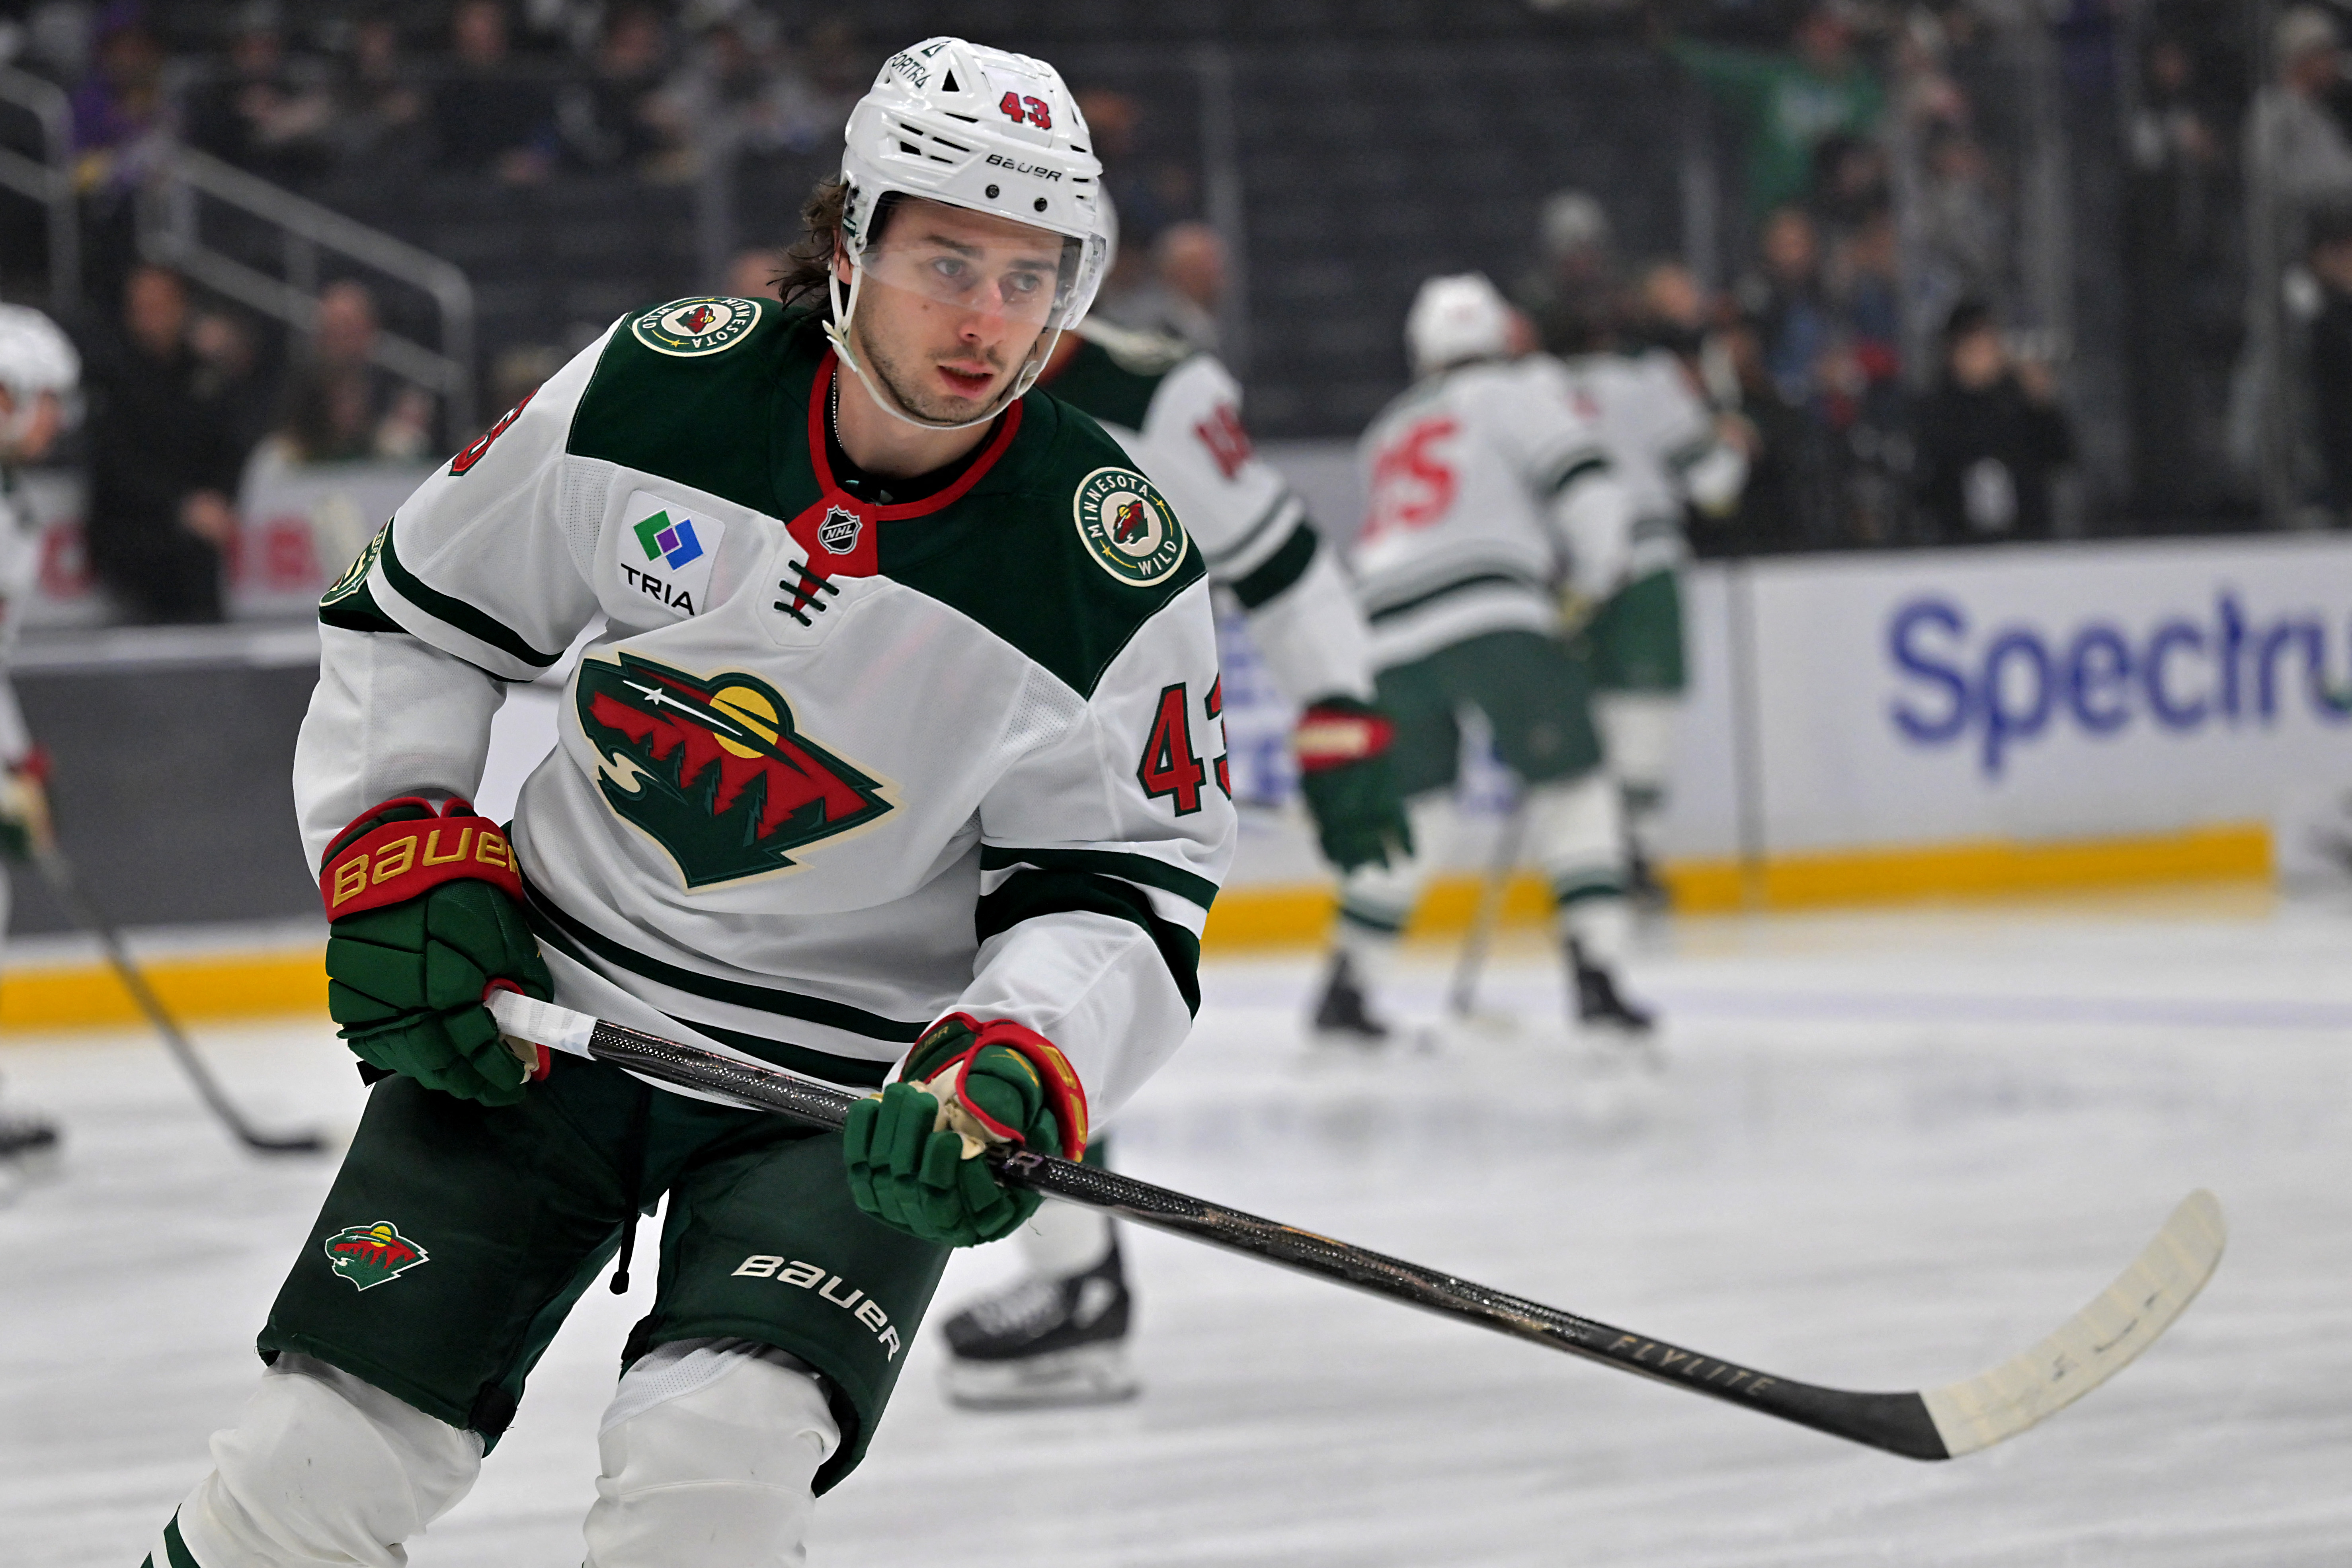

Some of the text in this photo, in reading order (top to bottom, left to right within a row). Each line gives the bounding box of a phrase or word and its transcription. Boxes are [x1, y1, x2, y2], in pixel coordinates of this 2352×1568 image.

[999, 91, 1052, 131] 43
[642, 307, 674, 329] WILD
[691, 298, 751, 349] MINNESOTA
[1083, 475, 1149, 538] MINNESOTA
[368, 531, 383, 562] 2025
[825, 524, 853, 540] NHL
[1137, 541, 1177, 576] WILD
[621, 562, 695, 616] TRIA
[731, 1255, 900, 1362] BAUER
[1606, 1335, 1776, 1396] FLYLITE
